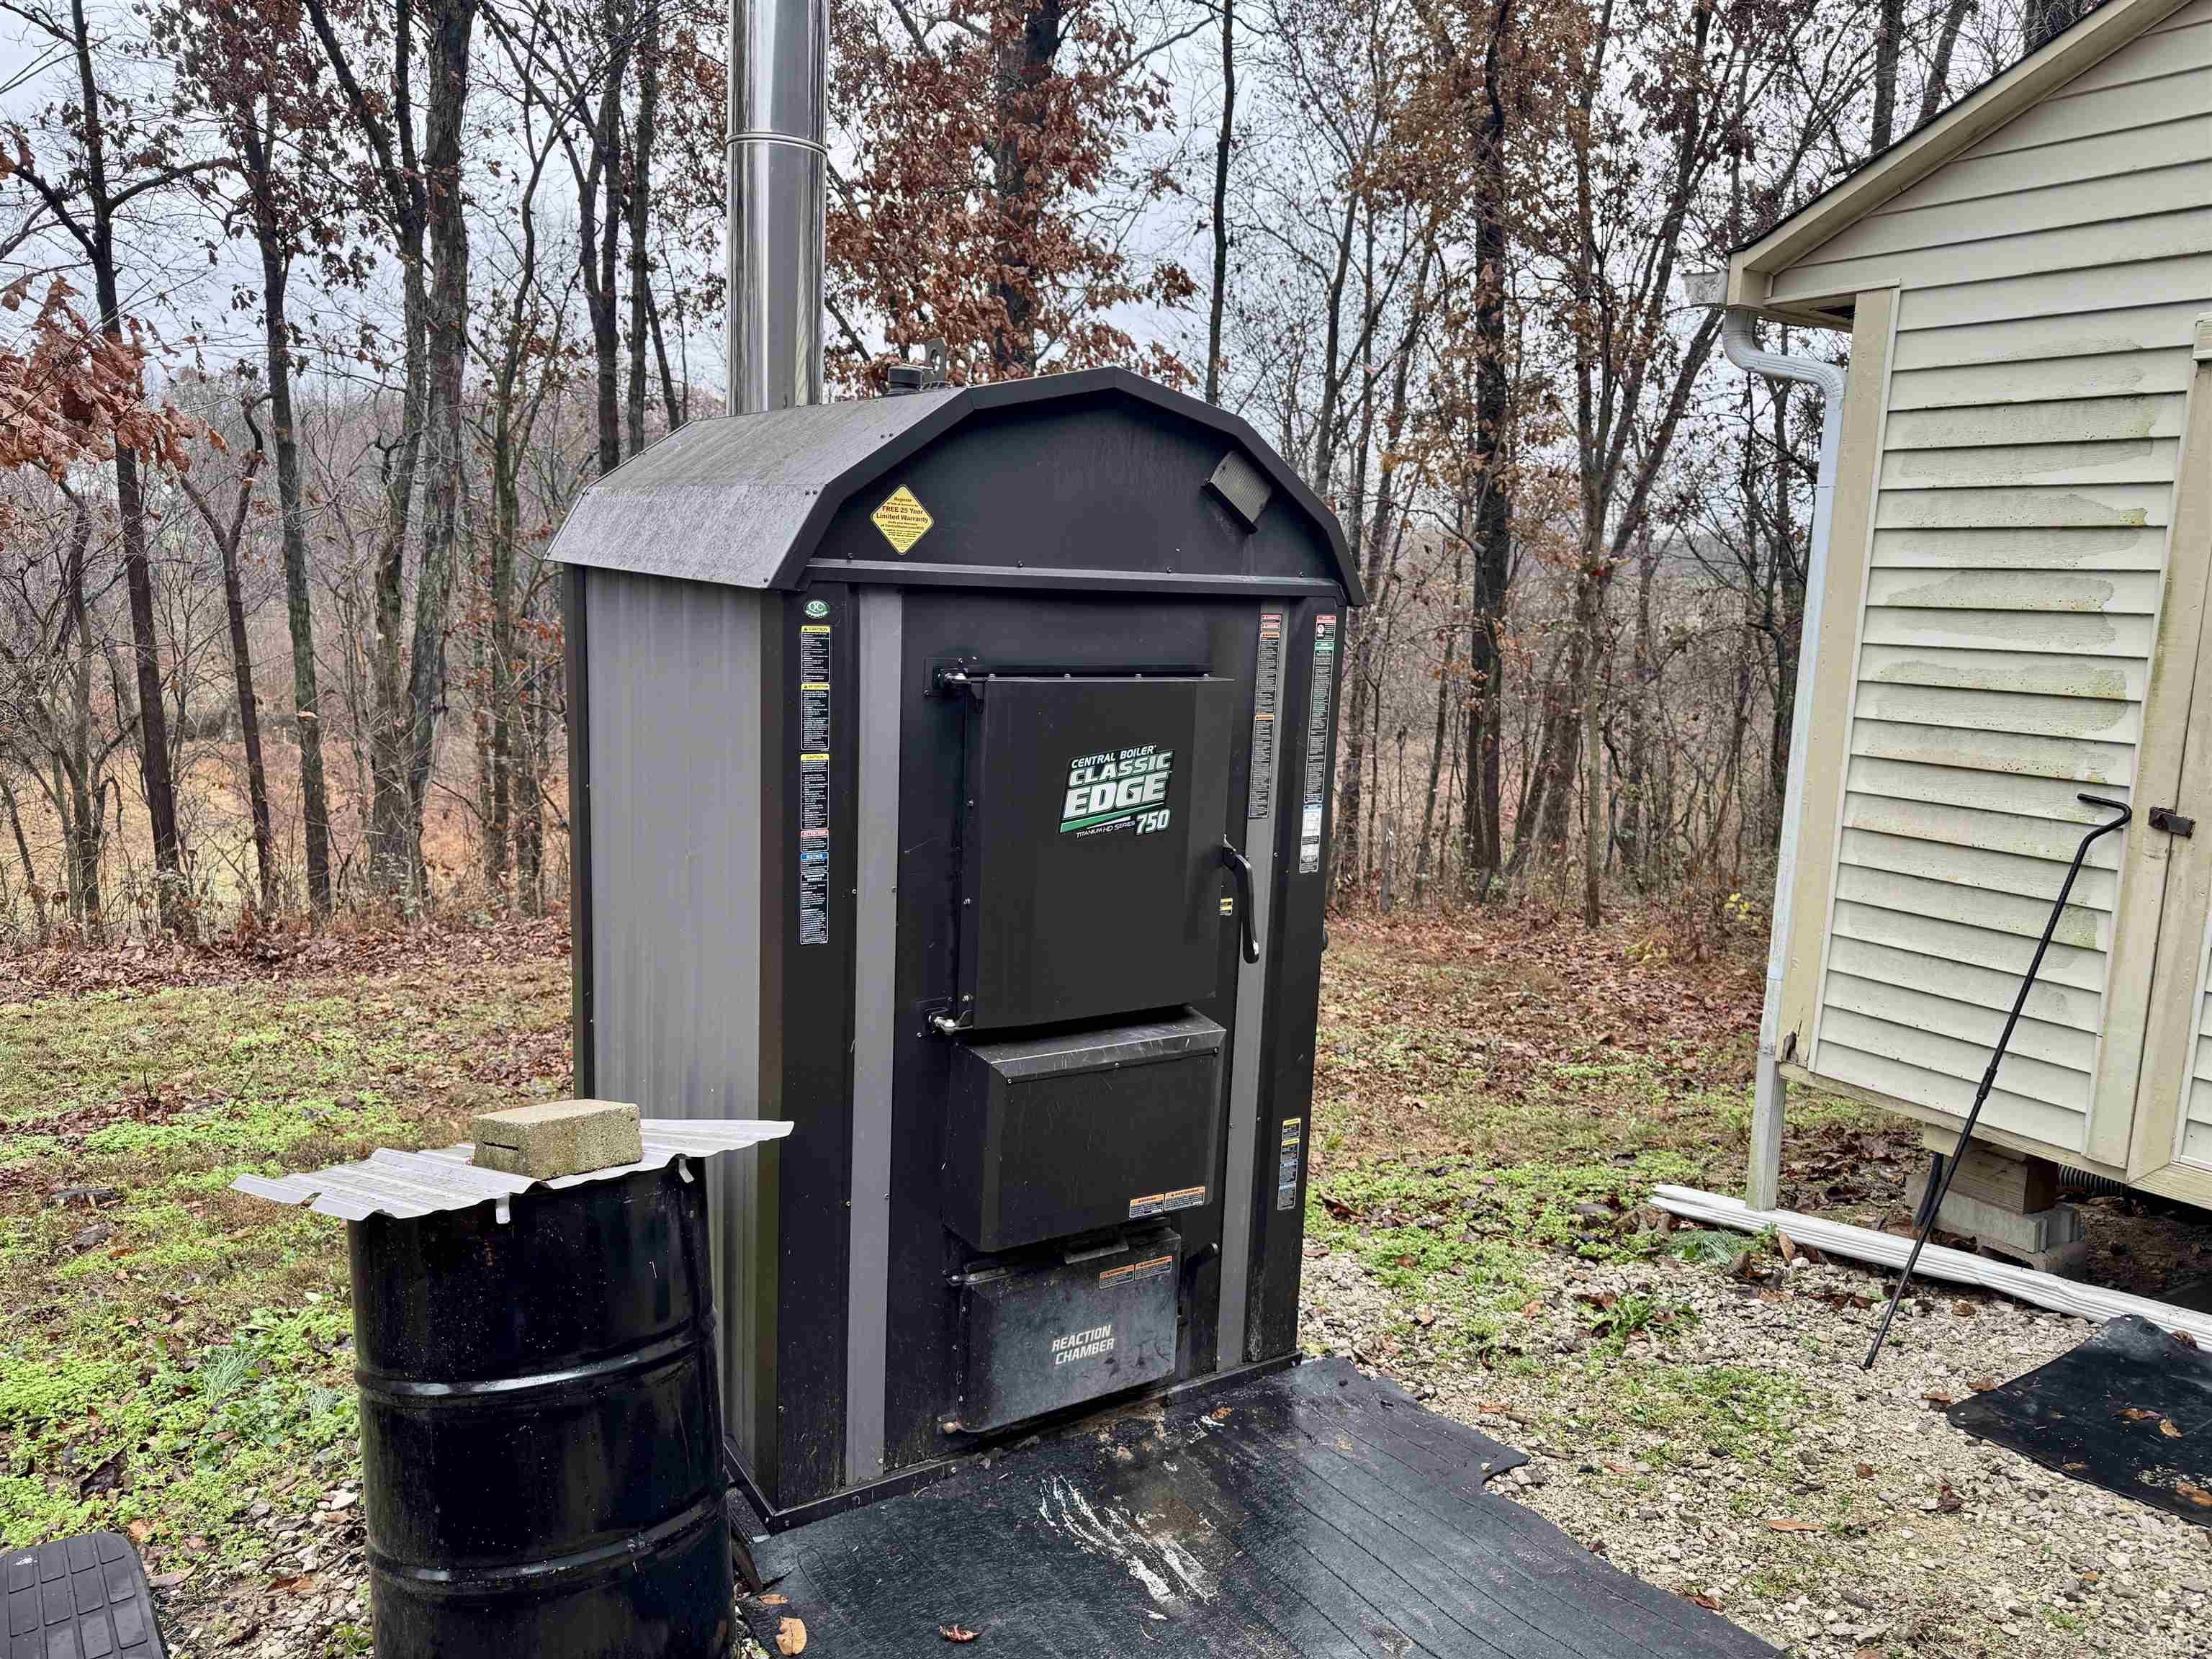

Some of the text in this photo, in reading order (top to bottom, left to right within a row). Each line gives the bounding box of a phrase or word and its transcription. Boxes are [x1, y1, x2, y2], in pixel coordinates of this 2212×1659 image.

[900, 514, 928, 524] Warranty
[1069, 751, 1173, 786] CLASSIC
[1071, 752, 1116, 768] CENTRAL
[1063, 770, 1169, 819] EDGE
[1076, 828, 1102, 839] TITANIUM
[1114, 820, 1136, 830] SERIES
[1136, 809, 1170, 835] 750
[1052, 1324, 1111, 1352] REACTION
[1056, 1338, 1115, 1364] CHAMBER
